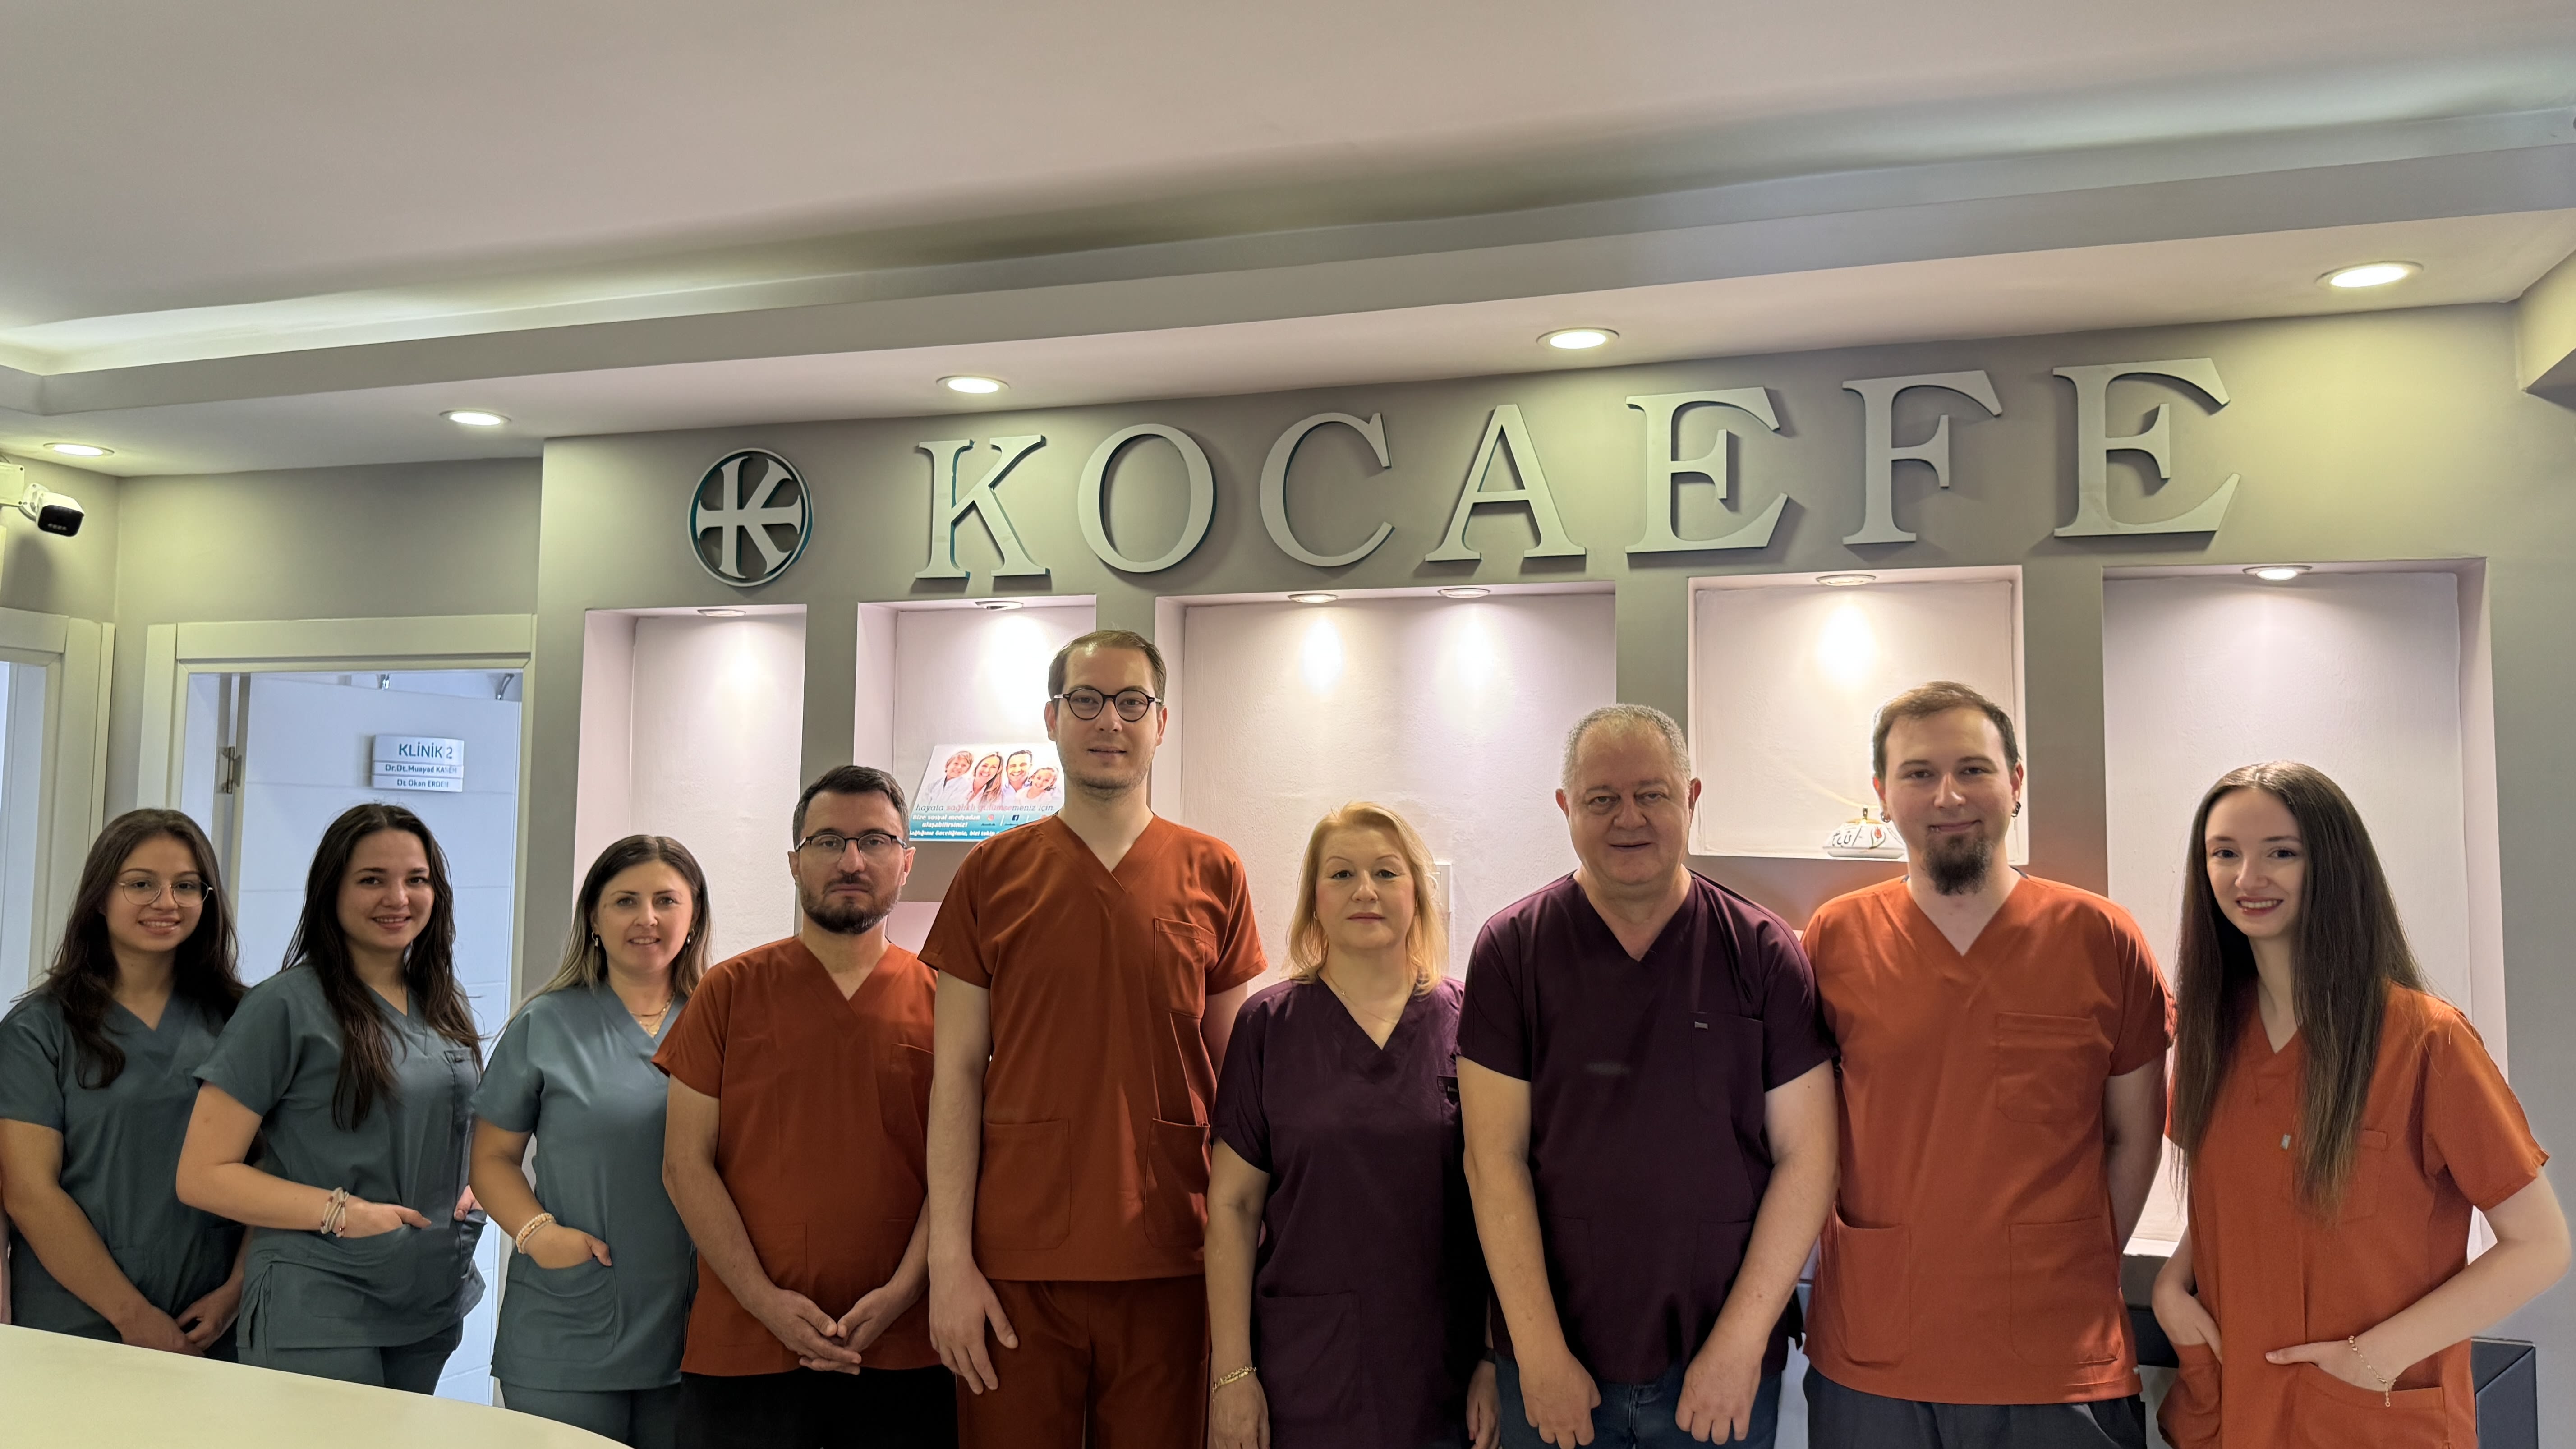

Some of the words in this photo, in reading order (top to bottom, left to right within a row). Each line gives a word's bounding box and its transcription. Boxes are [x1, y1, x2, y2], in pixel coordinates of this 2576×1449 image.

[915, 357, 2240, 580] KOCAEFE
[399, 742, 442, 758] KLİNİK
[446, 747, 452, 759] 2
[915, 804, 944, 812] hayata
